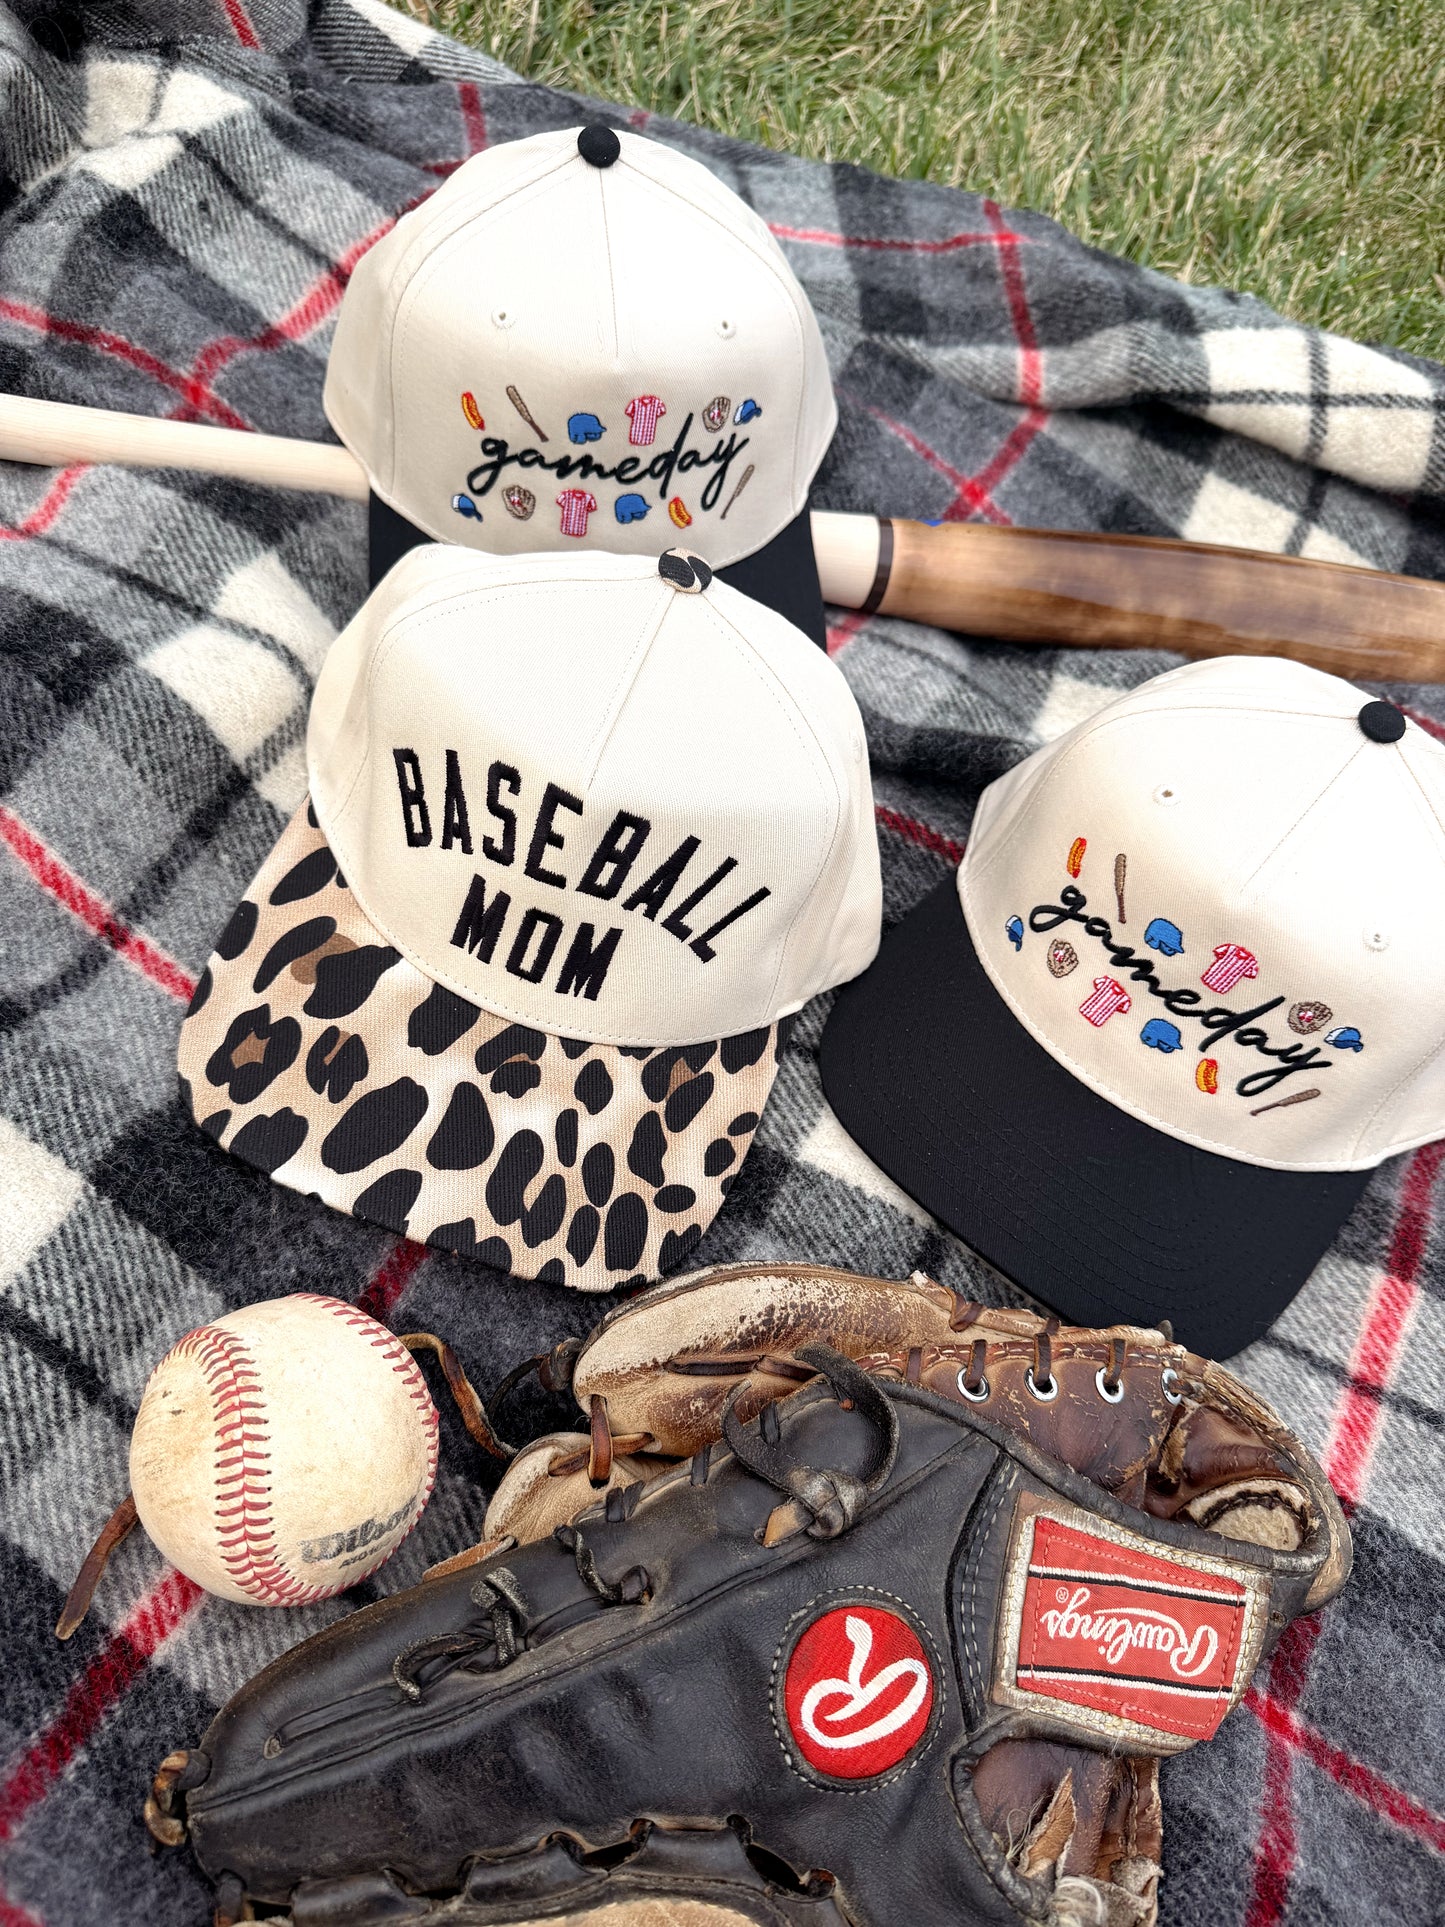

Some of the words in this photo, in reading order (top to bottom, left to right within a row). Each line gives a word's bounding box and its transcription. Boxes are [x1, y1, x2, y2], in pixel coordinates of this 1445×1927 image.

[467, 412, 751, 512] gameday
[392, 747, 772, 964] BASEBALL
[449, 873, 625, 1002] MOM
[1029, 884, 1333, 1097] gameday
